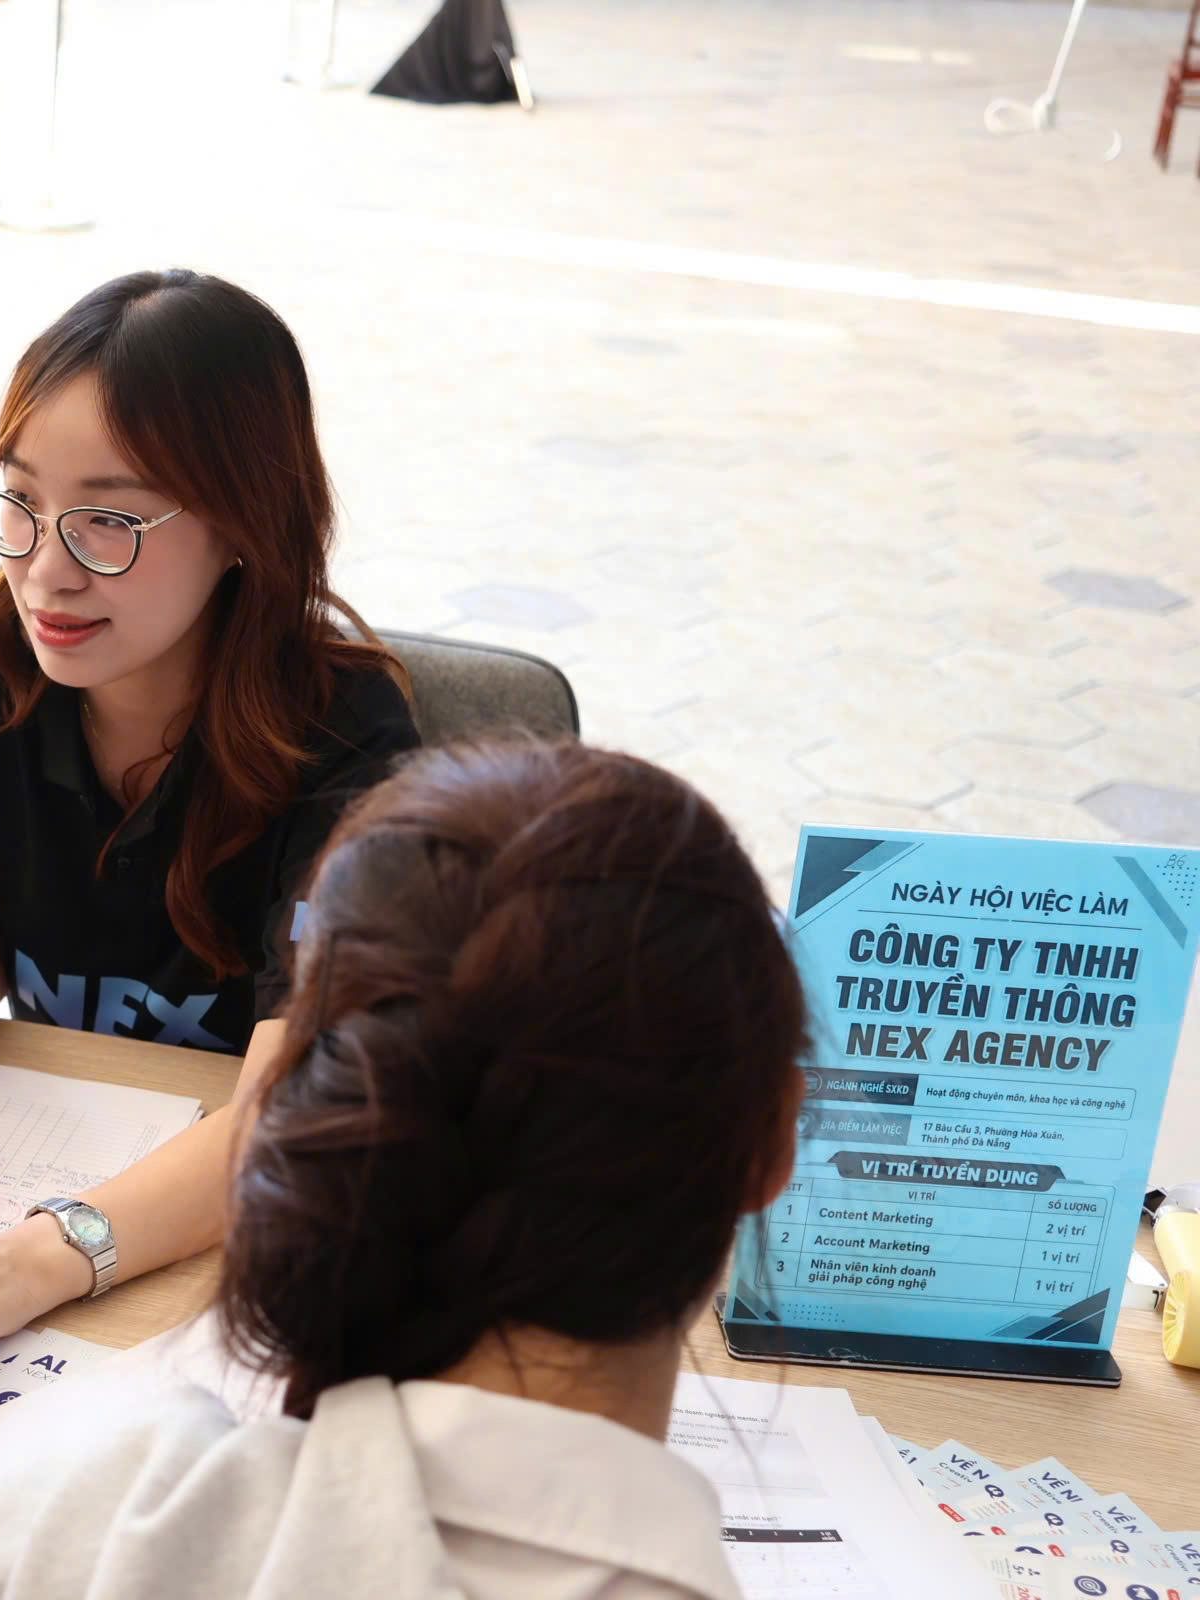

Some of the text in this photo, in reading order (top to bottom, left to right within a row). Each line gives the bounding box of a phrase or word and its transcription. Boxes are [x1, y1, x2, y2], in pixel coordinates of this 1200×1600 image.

[891, 879, 1129, 917] NGÀY HỘI VIỆC LÀM
[849, 923, 1140, 980] CÔNG TY TNHH
[15, 949, 235, 1049] NEX
[835, 973, 1137, 1028] TRUYỀN THÔNG
[846, 1022, 1111, 1072] NEX AGENCY
[826, 1080, 857, 1091] NGÀNH
[886, 1085, 909, 1095] SXKD
[926, 1087, 1126, 1110] Hoạt động chuyên môn, khoa học và công nghệ
[921, 1134, 949, 1144] Thành
[972, 1137, 984, 1146] Đà
[923, 1123, 932, 1131] 17
[974, 1127, 982, 1136] 3,
[1040, 1131, 1064, 1141] Xuân,
[862, 1159, 1038, 1186] VỊ TRÍ TUYỂN DỤNG
[920, 1190, 936, 1201] TRÍ
[786, 1205, 793, 1216] 1
[1048, 1199, 1096, 1213] SỐ LƯỢNG
[819, 1208, 933, 1227] Content Marketing
[781, 1232, 790, 1243] 2
[1046, 1224, 1086, 1237] 2 vị trí
[815, 1235, 930, 1254] Account Marketing
[776, 1261, 784, 1272] 3
[1042, 1251, 1080, 1264] 1 vị trí
[811, 1259, 936, 1277] Nhân viên kinh doanh
[808, 1272, 927, 1290] giải pháp công nghệ
[1036, 1280, 1074, 1294] 1 vị trí
[951, 1454, 977, 1470] VỀ
[1042, 1472, 1070, 1489] VỀ
[1107, 1506, 1136, 1524] VỀ
